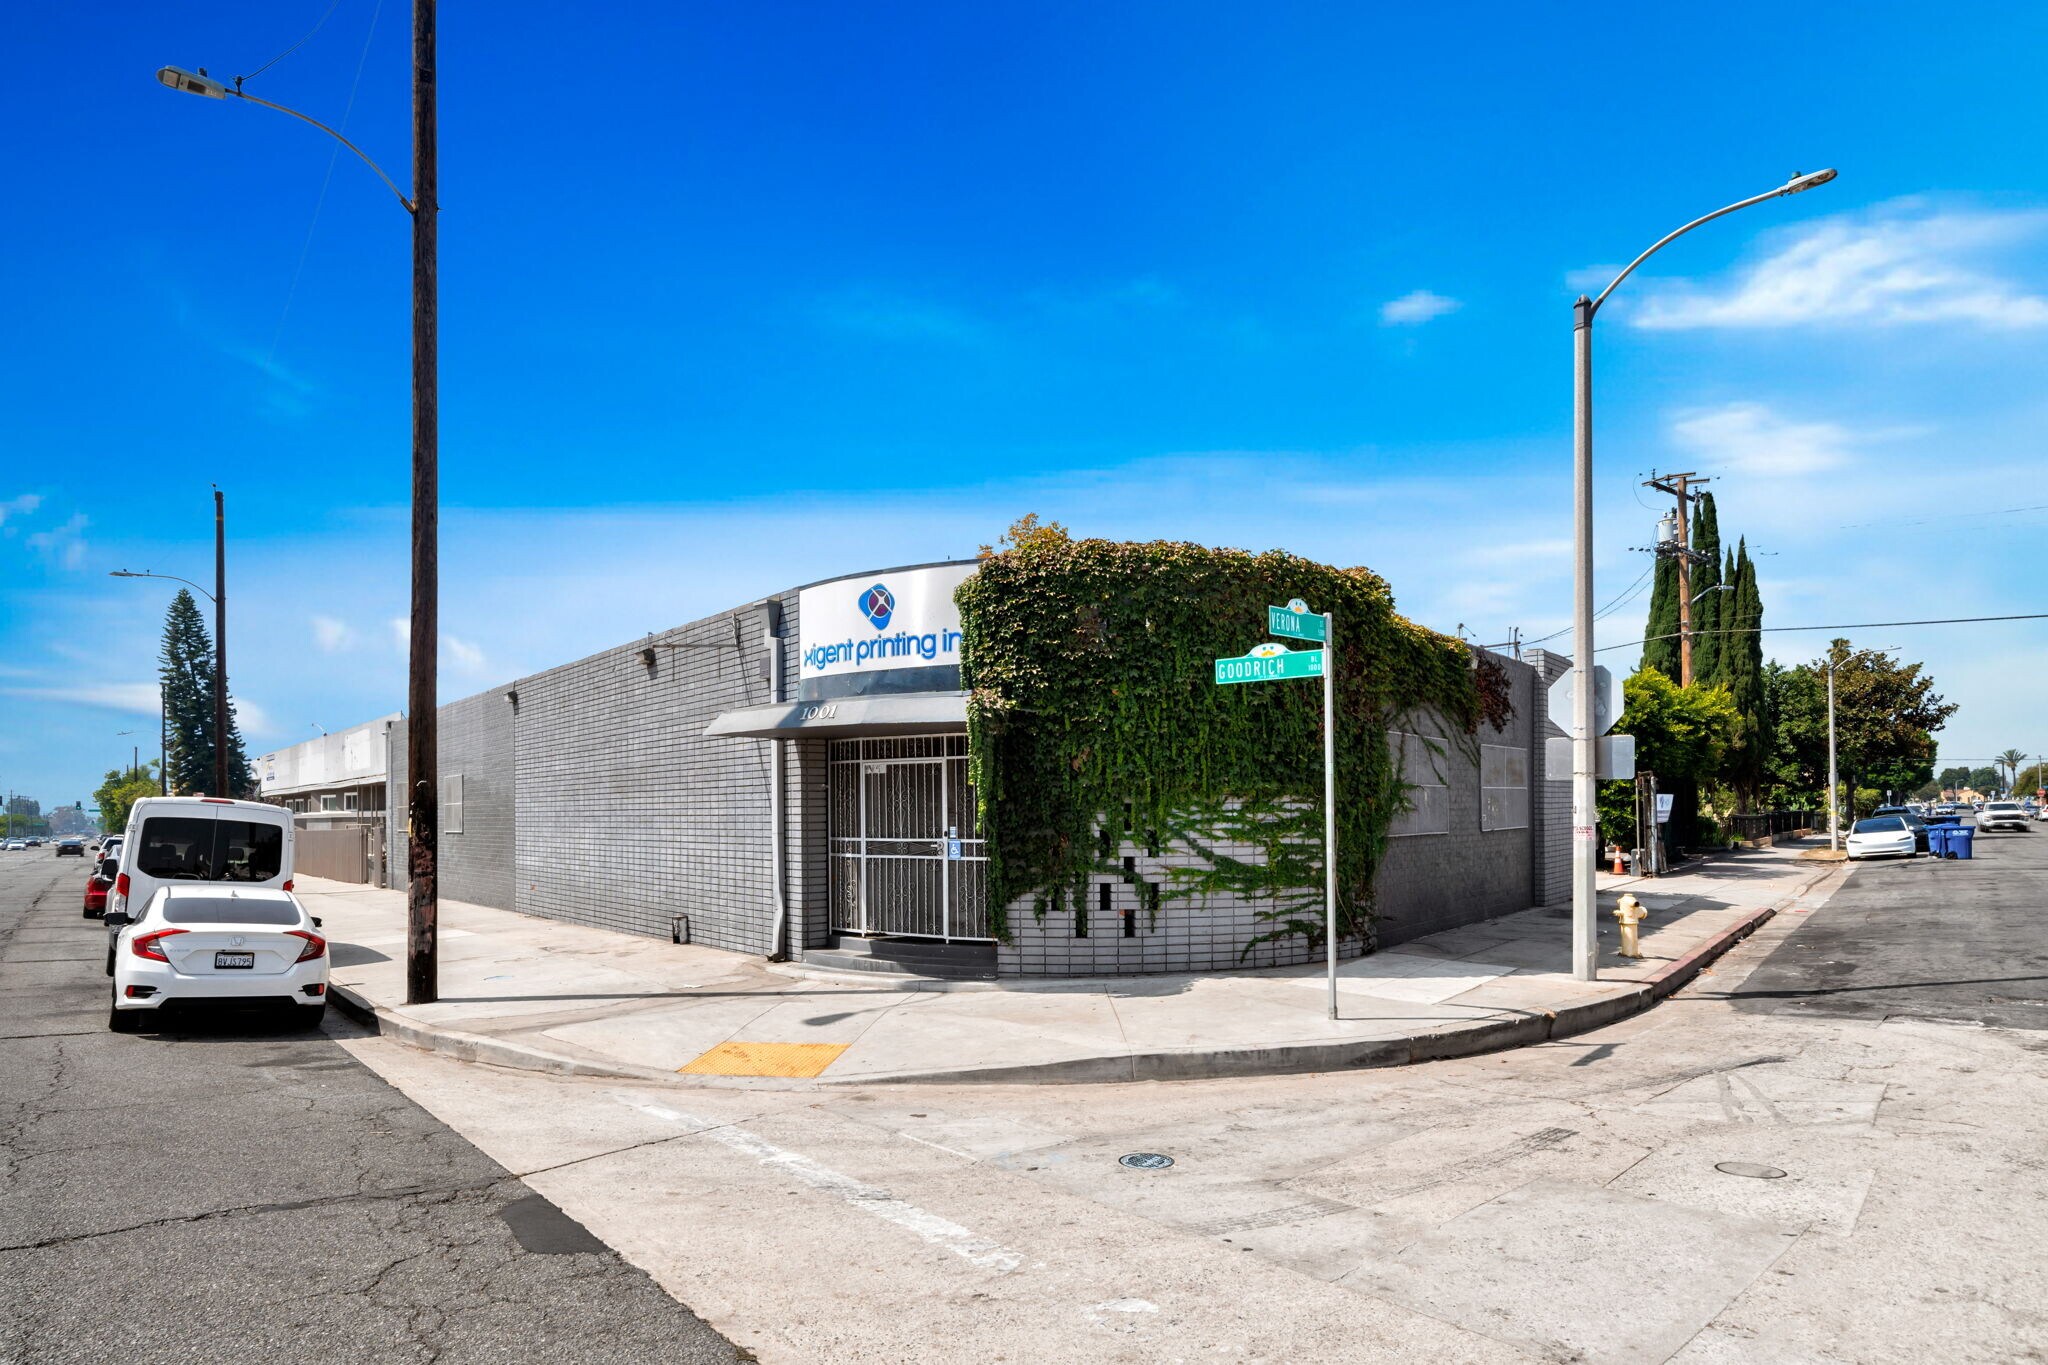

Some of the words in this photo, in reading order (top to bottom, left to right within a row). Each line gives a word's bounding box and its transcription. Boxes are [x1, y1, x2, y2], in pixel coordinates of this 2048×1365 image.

[1271, 611, 1301, 633] VERONA
[804, 639, 854, 670] xigent
[856, 631, 937, 666] printing
[1218, 659, 1285, 679] GOODRICH
[800, 704, 838, 721] 1001
